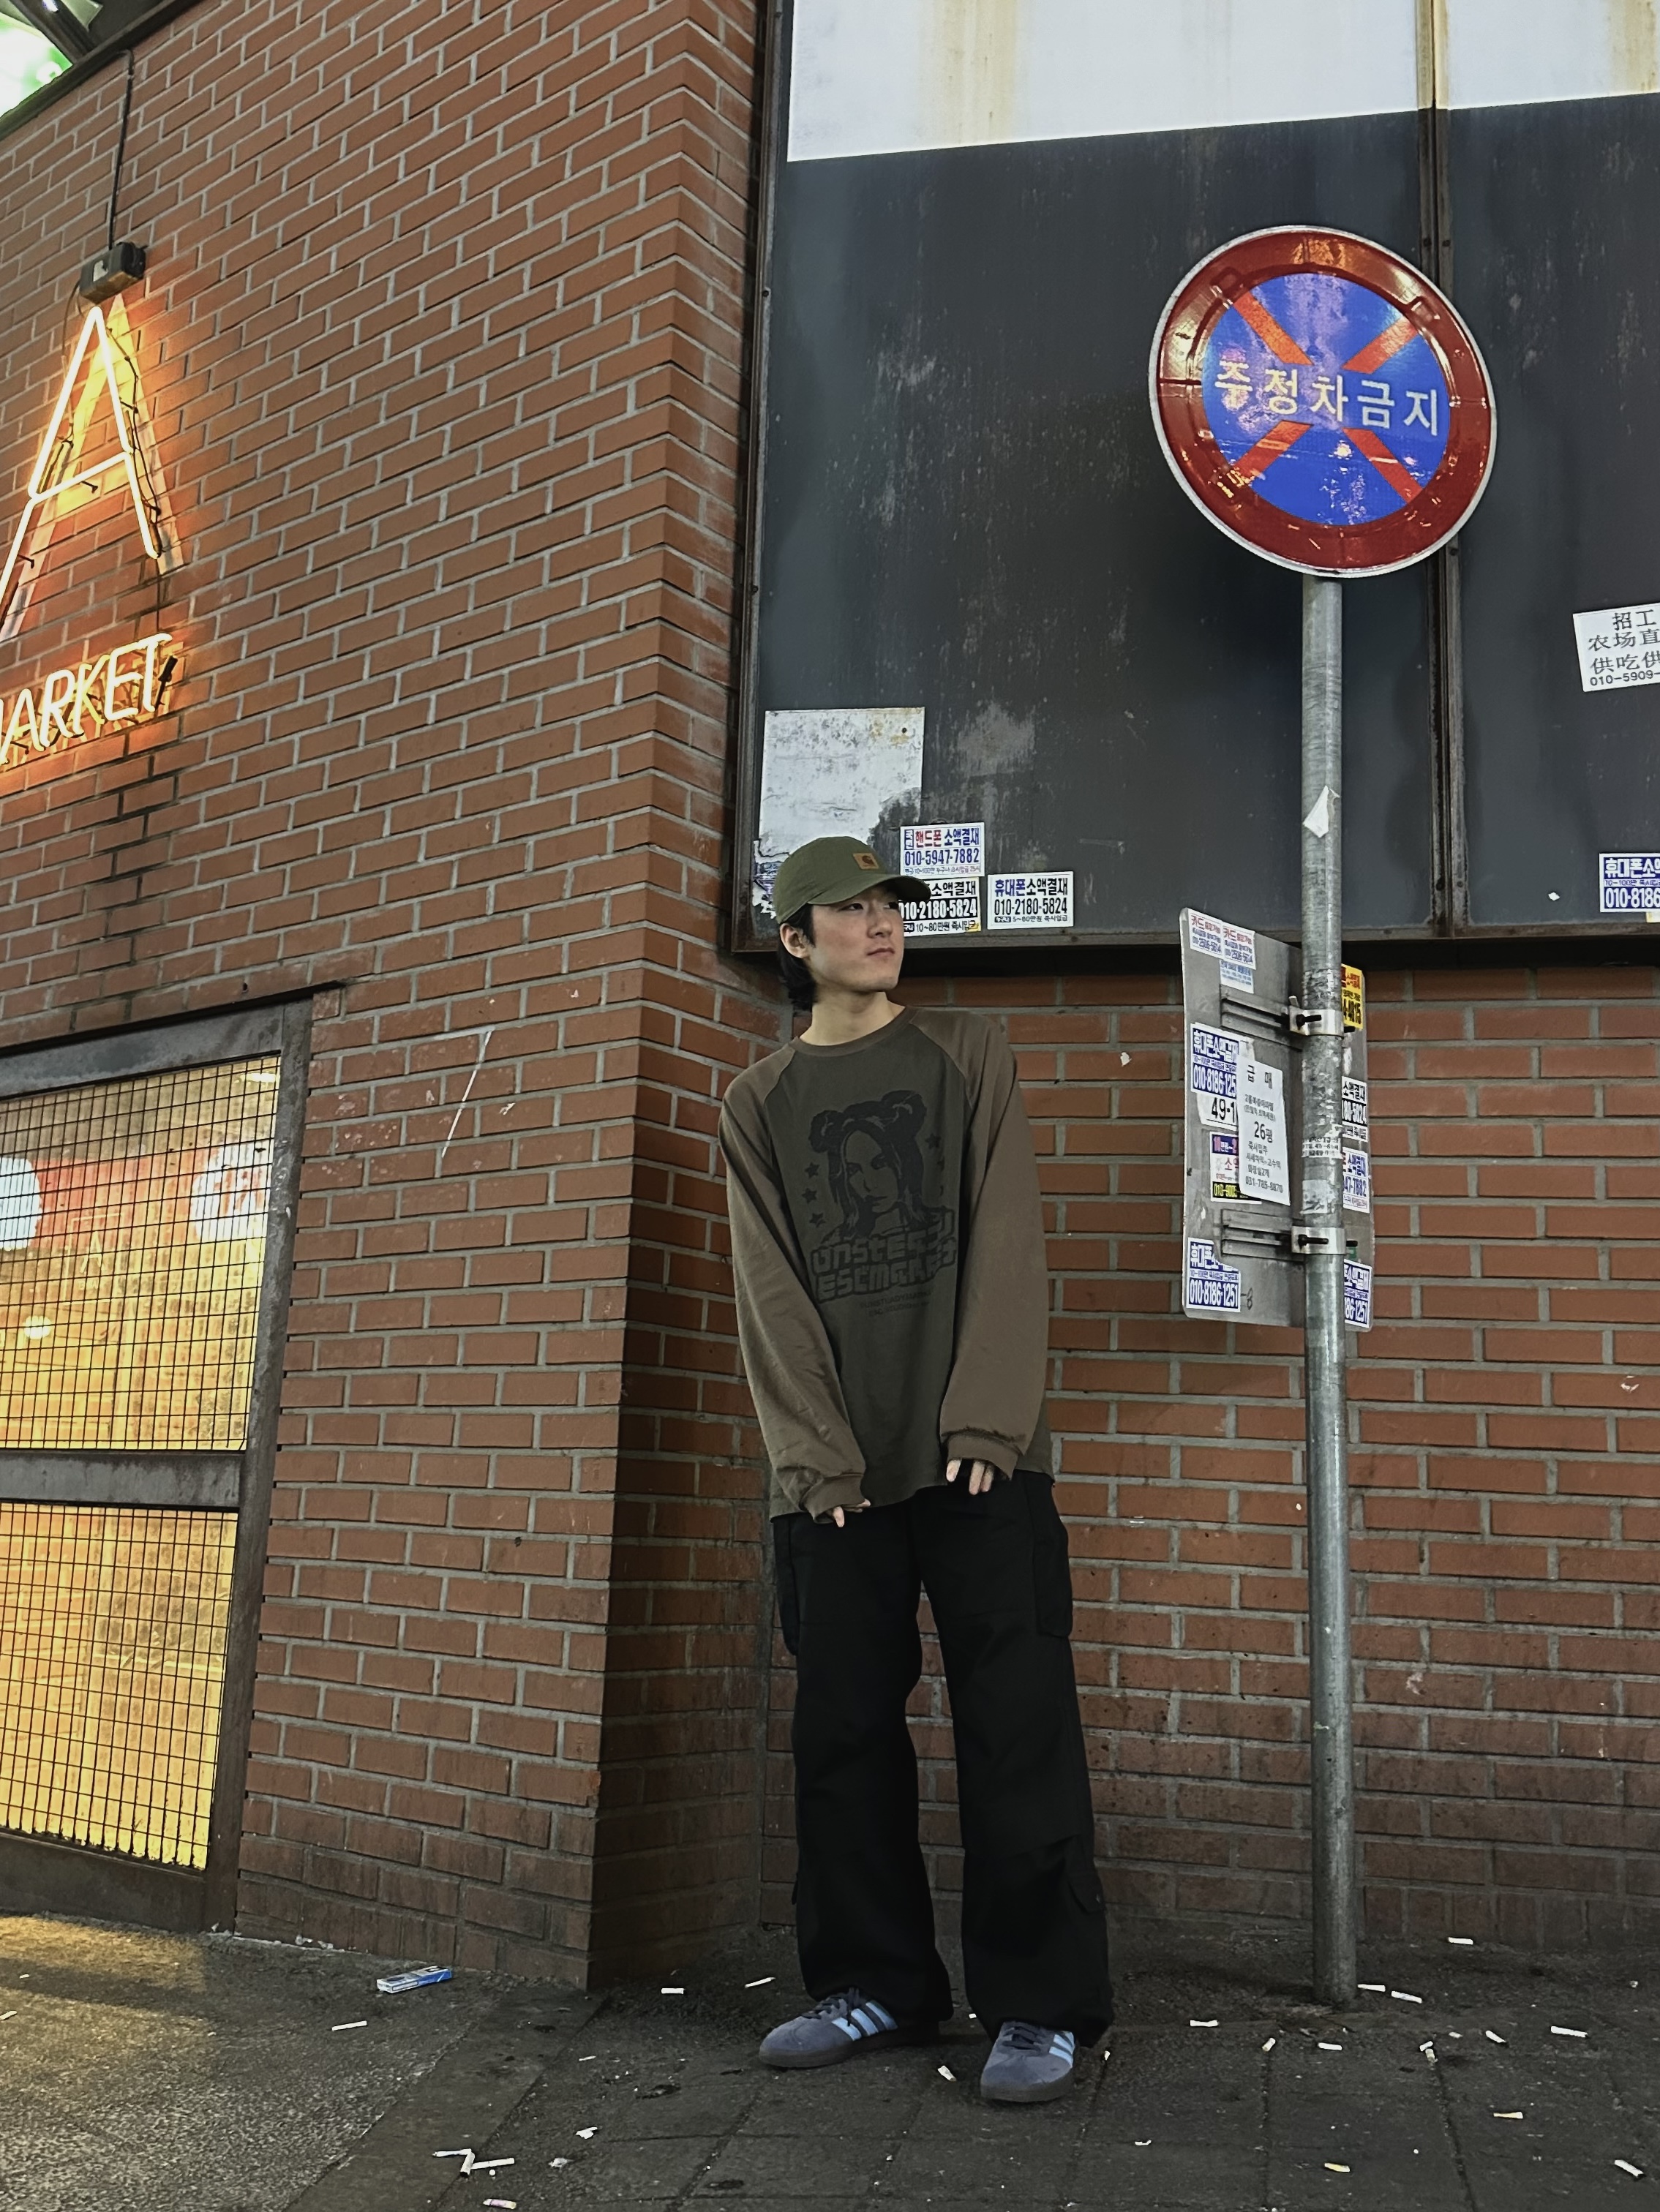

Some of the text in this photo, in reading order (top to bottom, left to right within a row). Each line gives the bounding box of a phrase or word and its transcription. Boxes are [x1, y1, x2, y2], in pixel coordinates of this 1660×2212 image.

[1214, 360, 1439, 437] 주정차금지
[1612, 609, 1657, 631] 招工
[0, 632, 173, 766] ARKET
[915, 830, 942, 848] 핸드폰
[904, 848, 980, 866] 010-5947-7882
[927, 880, 976, 896] 소액결재
[994, 898, 1067, 915] 010-2180-5824
[1254, 1121, 1273, 1143] 26평
